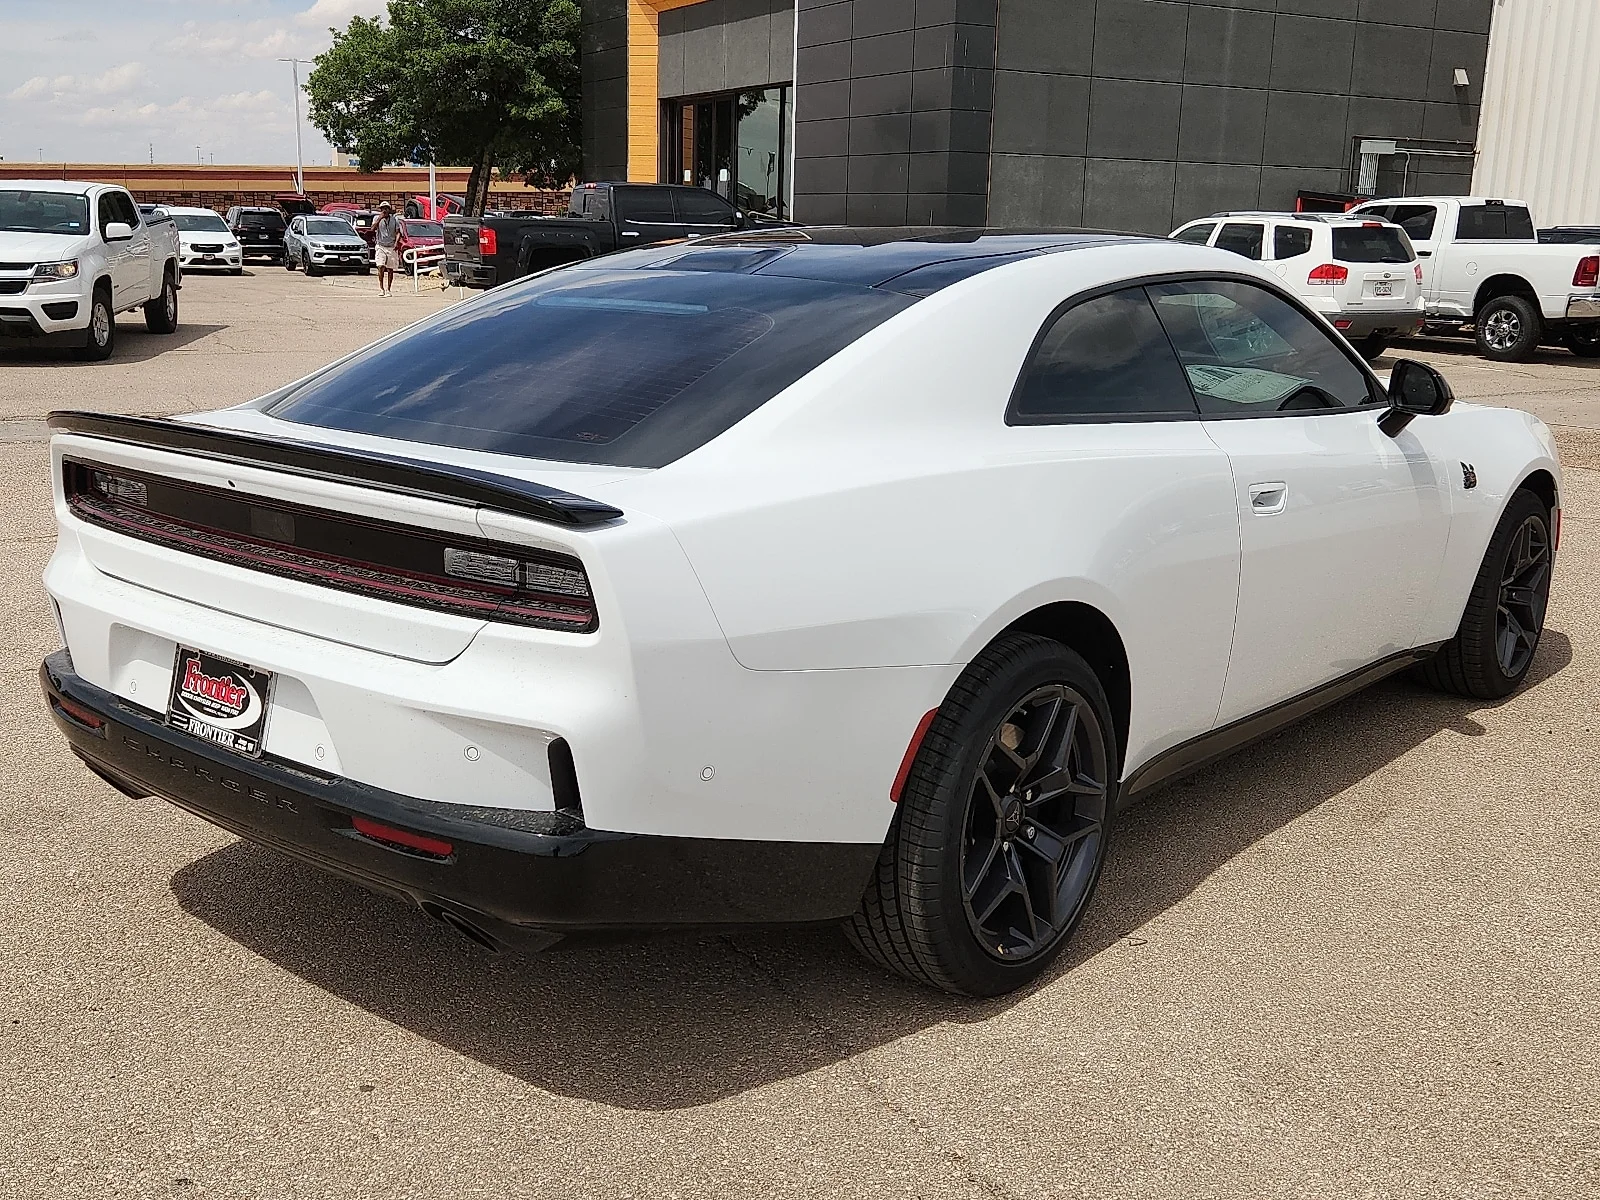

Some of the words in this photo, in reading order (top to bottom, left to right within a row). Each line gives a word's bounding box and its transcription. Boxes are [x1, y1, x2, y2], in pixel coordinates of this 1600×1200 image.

[183, 659, 246, 710] Frontier
[188, 719, 235, 747] FRONTIER
[122, 735, 299, 814] CHARGER
